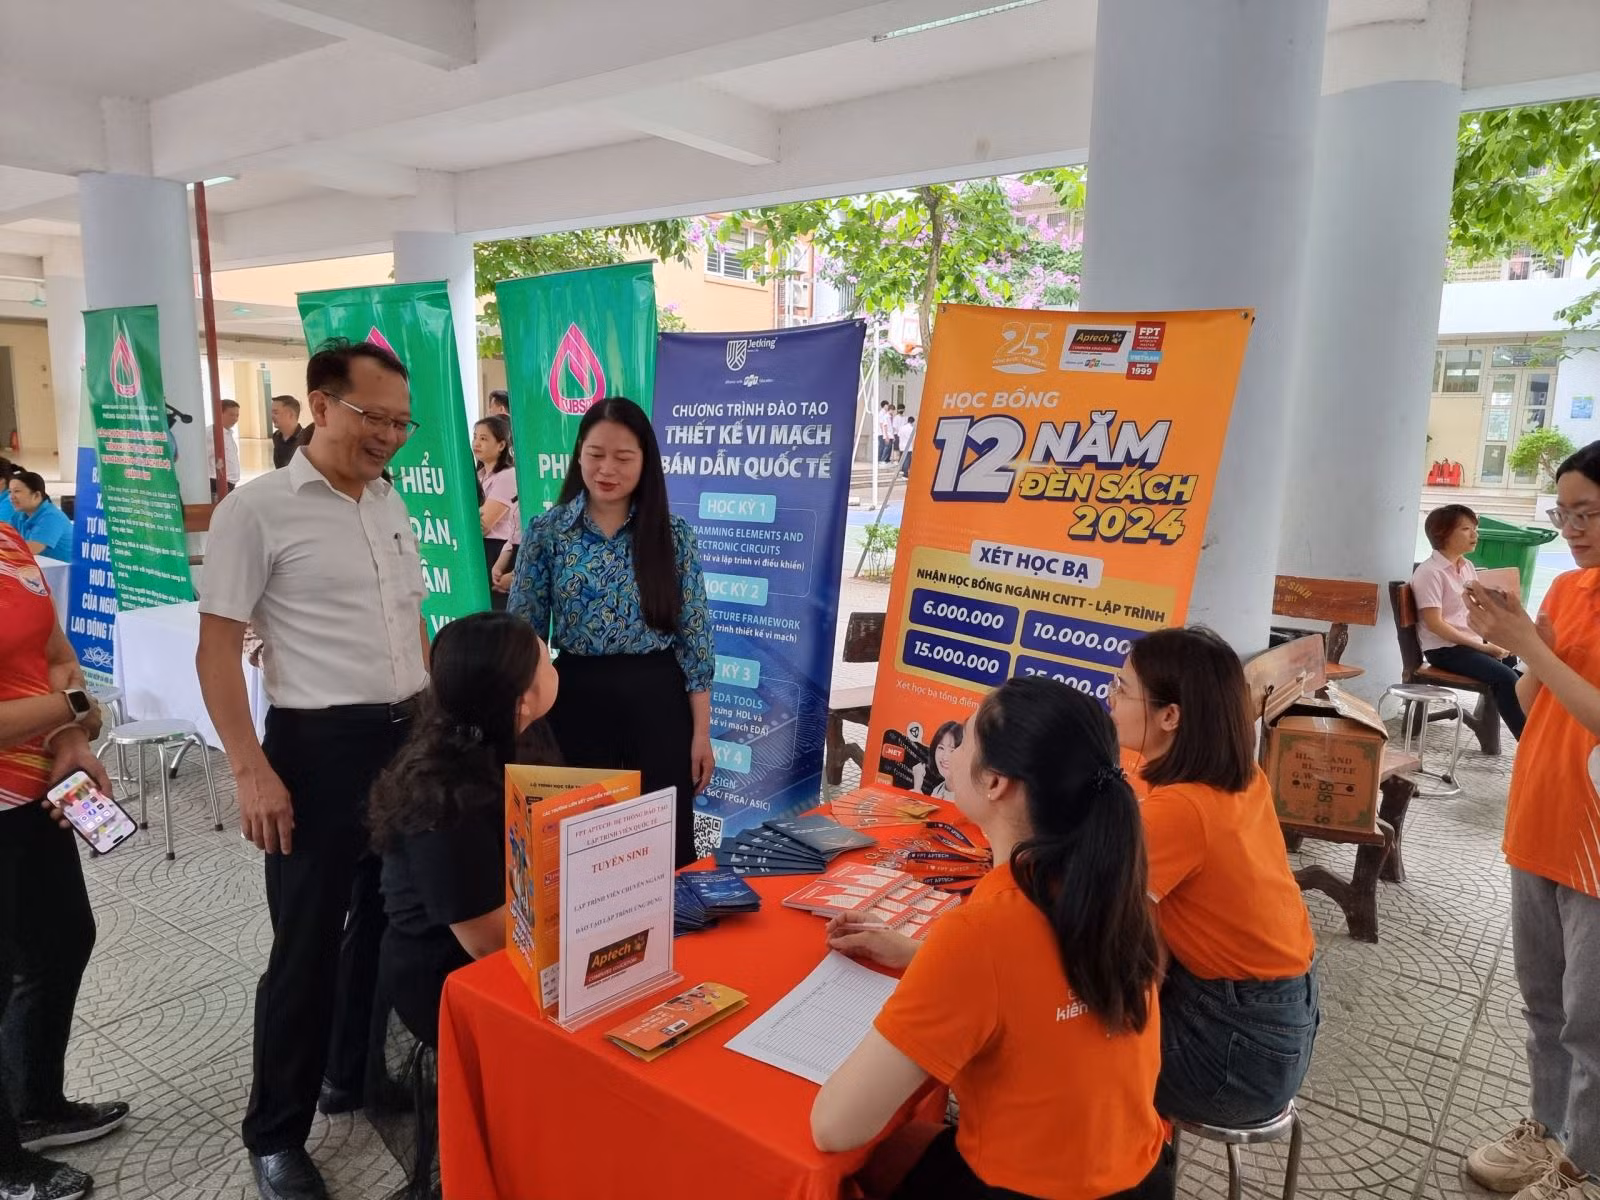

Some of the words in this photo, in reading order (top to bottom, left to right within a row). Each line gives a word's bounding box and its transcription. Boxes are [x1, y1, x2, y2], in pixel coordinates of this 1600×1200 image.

[1077, 332, 1110, 343] Aptech
[1139, 327, 1161, 336] FPT
[747, 338, 777, 350] Jetking
[1131, 367, 1152, 375] 1999
[672, 402, 724, 418] CHƯƠNG
[727, 400, 764, 416] TRÌNH
[767, 400, 797, 416] ĐÀO
[801, 401, 829, 419] TẠO
[943, 392, 986, 413] HỌC
[992, 386, 1061, 410] BỔNG
[665, 418, 716, 445] THIẾT
[718, 419, 744, 445] KẾ
[746, 425, 766, 445] VI
[770, 424, 832, 451] MẠCH
[661, 452, 697, 476] BÁN
[700, 448, 740, 476] DẪN
[743, 451, 803, 480] QUỐC
[806, 451, 832, 479] TẾ
[931, 414, 1027, 502] 12
[1030, 410, 1172, 470] NĂM
[401, 451, 445, 495] HIỂU
[1019, 463, 1093, 502] ĐÈN
[1096, 468, 1199, 505] SÁCH
[707, 499, 736, 517] HỌC
[738, 498, 757, 515] KỲ
[759, 502, 766, 516] 1
[409, 510, 458, 551] DÂN,
[692, 525, 734, 537] RAMMING
[736, 528, 781, 541] ELEMENTS
[783, 532, 804, 542] AND
[1068, 506, 1186, 545] 2024
[698, 540, 739, 552] ECTRONIC
[740, 543, 781, 555] CIRCUITS
[979, 546, 1014, 567] XÉT
[1016, 551, 1059, 576] HỌC
[1062, 560, 1089, 584] BẠ
[421, 559, 451, 594] ÂM
[751, 584, 759, 599] 2
[916, 568, 947, 583] NHẬN
[948, 573, 969, 588] HỌC
[1005, 584, 1050, 602] NGÀNH
[1052, 593, 1087, 608] CNTT
[1095, 600, 1121, 616] LẬP
[1123, 605, 1166, 623] TRÌNH
[709, 609, 741, 622] ECTURE
[742, 613, 801, 630] FRAMEWORK
[923, 599, 1005, 630] 6.000.000
[71, 616, 85, 634] LAO
[1033, 622, 1132, 655] 10.000.00
[913, 640, 1000, 674] 15.000.000
[722, 662, 739, 679] KỲ
[743, 667, 751, 681] 3
[713, 691, 731, 704] EDA
[733, 695, 763, 709] TOOLS
[736, 709, 752, 720] HDL
[728, 722, 749, 732] mạch
[750, 725, 769, 737] EDA)
[734, 751, 742, 765] 4
[710, 775, 736, 789] ESIGN
[707, 787, 723, 799] SoC/
[724, 792, 748, 805] FPGA/
[749, 798, 771, 812] ASIC)
[626, 846, 649, 862] SINH
[591, 943, 631, 968] Aptech
